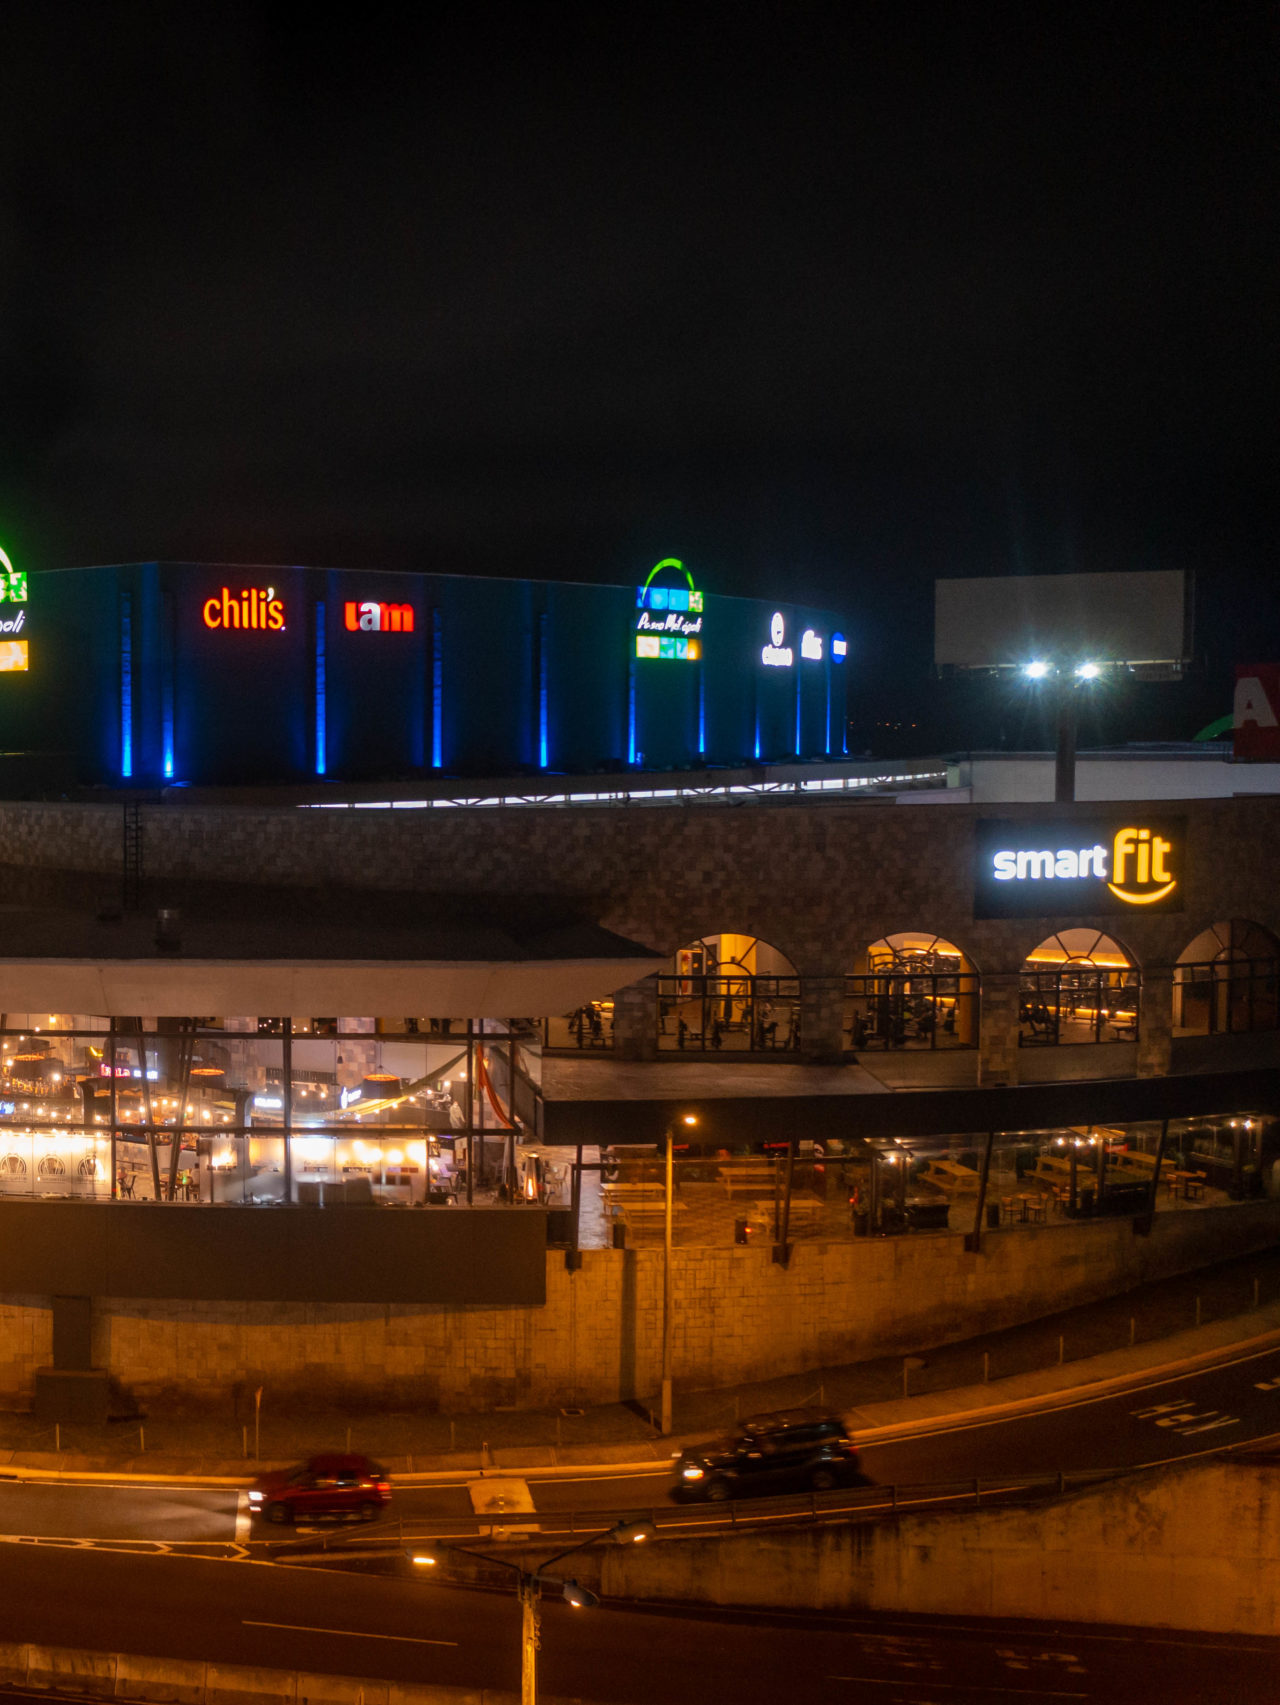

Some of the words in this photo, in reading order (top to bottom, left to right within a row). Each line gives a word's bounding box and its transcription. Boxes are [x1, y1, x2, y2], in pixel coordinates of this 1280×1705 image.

[204, 587, 284, 629] chili's
[993, 845, 1108, 880] smart
[1112, 827, 1172, 884] fit
